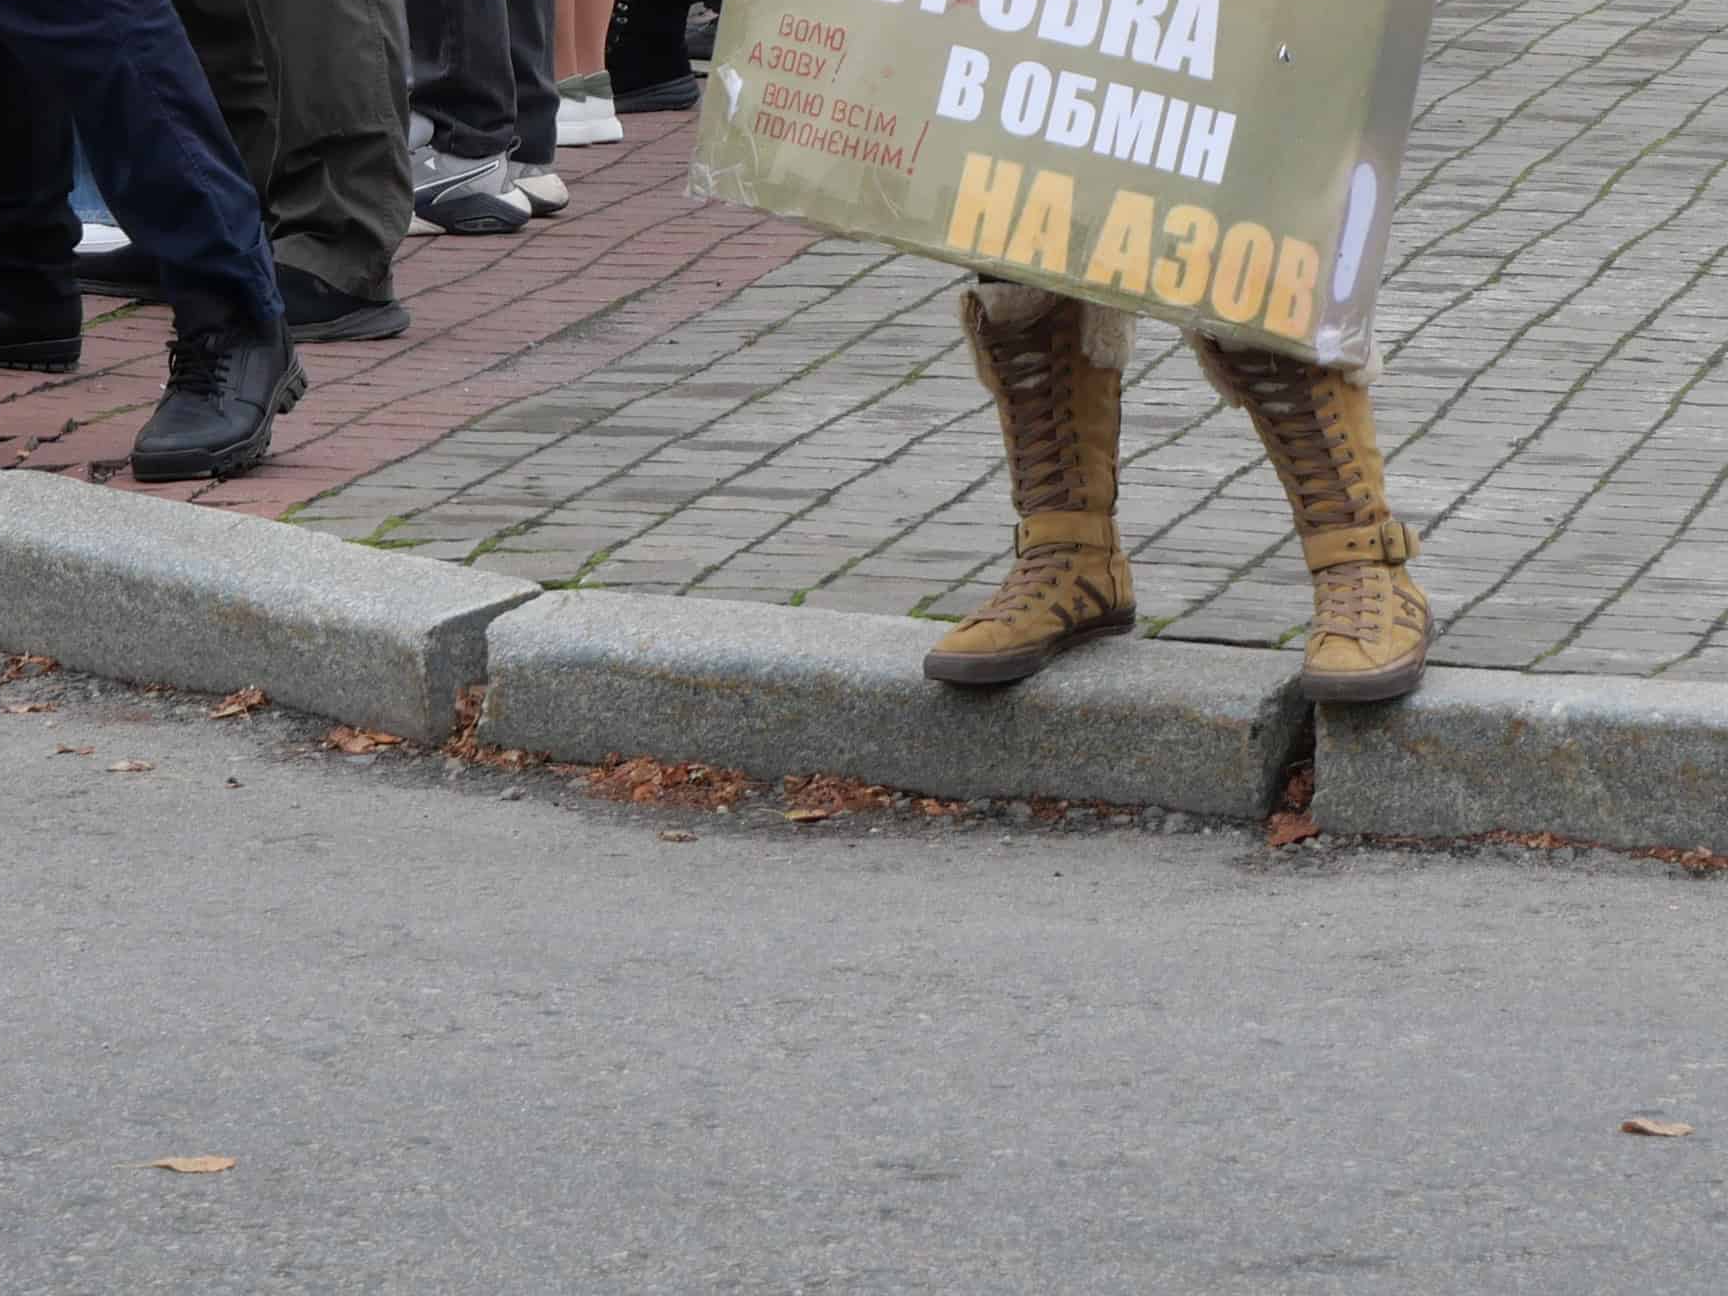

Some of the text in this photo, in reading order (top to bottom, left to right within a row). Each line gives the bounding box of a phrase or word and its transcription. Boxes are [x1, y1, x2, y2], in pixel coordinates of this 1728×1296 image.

[778, 13, 847, 52] ВОЛЮ
[761, 82, 898, 137] ВОЛЮ ВСІМ
[936, 45, 1239, 186] В ОБМІН
[946, 152, 1074, 274] НА
[1085, 188, 1322, 340] АЗОВ
